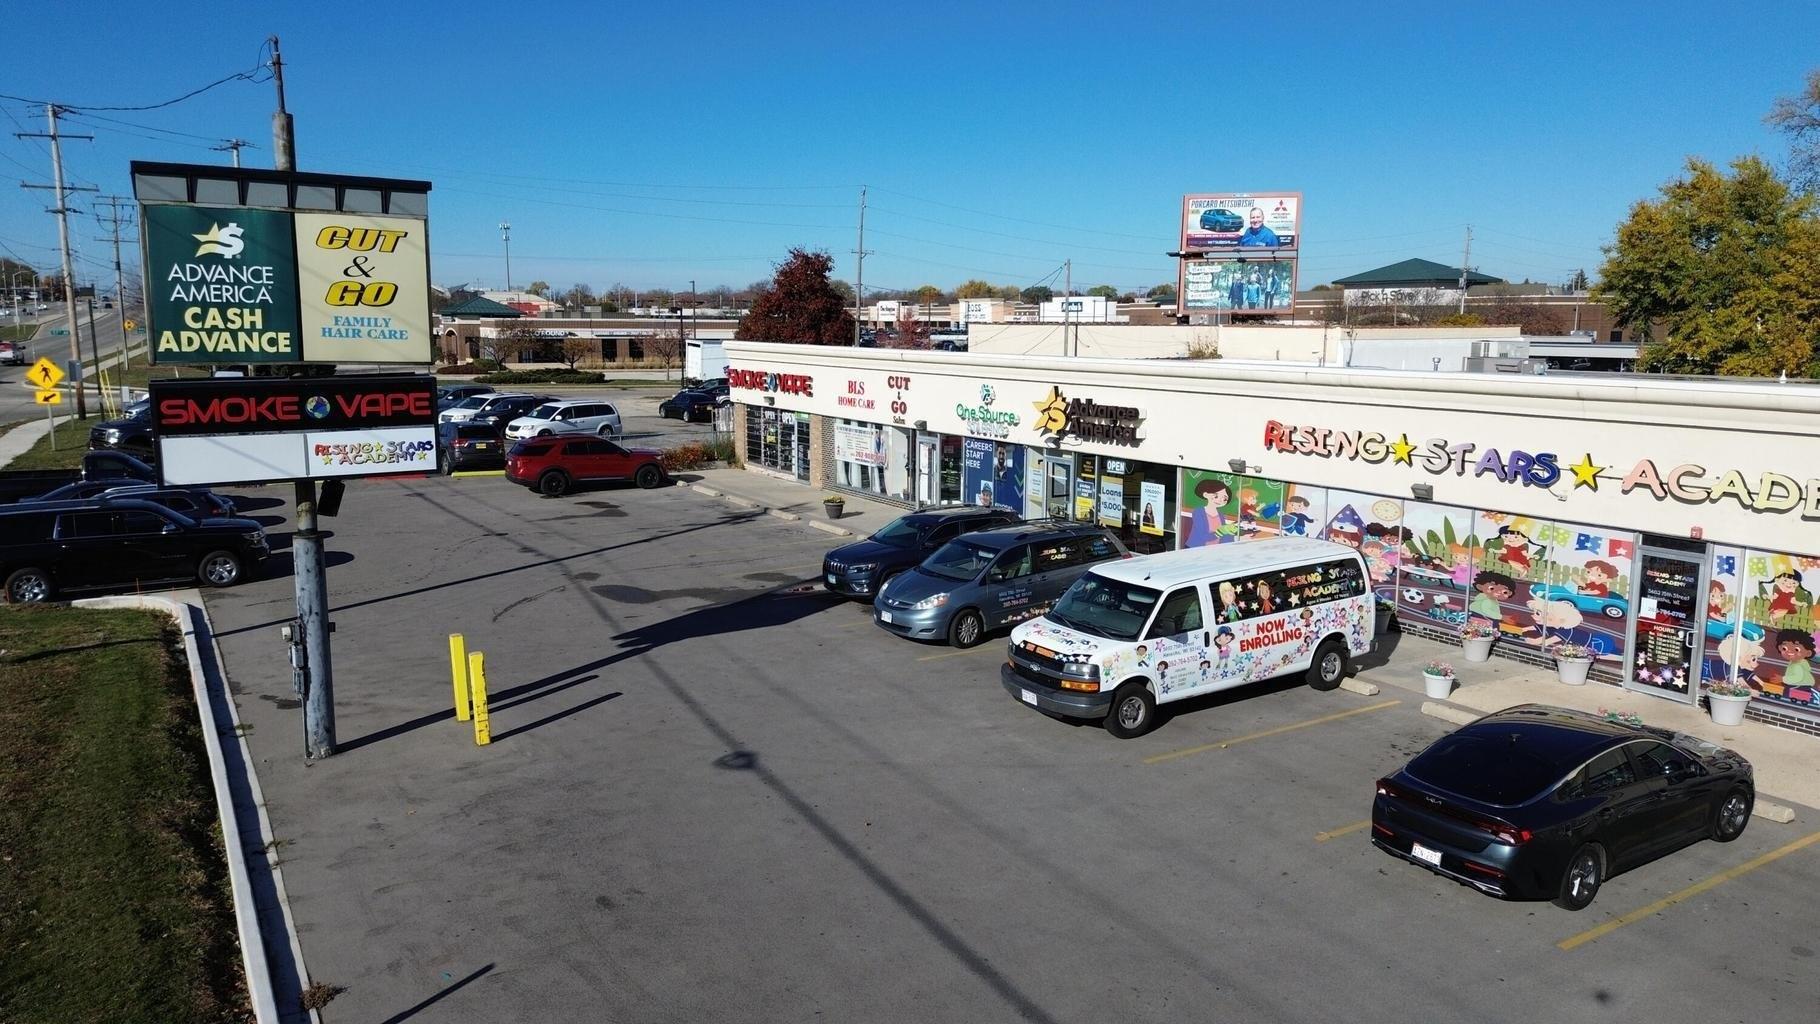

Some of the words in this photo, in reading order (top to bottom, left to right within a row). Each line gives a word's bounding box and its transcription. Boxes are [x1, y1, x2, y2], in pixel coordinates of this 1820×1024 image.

[316, 226, 408, 253] CUT
[168, 263, 274, 284] ADVANCE
[343, 256, 375, 278] &
[170, 283, 274, 304] AMERICA
[325, 281, 398, 307] GO
[184, 307, 263, 329] CASH
[333, 316, 391, 328] FAMILY
[321, 327, 362, 338] HAIR
[367, 329, 409, 340] CARE
[158, 331, 291, 353] ADVANCE
[728, 368, 768, 392] SMOKE
[777, 373, 814, 398] VAPE
[847, 380, 865, 395] BLS
[888, 376, 911, 391] CUT
[160, 396, 300, 424] SMOKE
[336, 392, 431, 418] VAPE
[838, 396, 857, 407] HOME
[858, 398, 875, 410] CARE
[891, 401, 907, 415] GO
[1069, 398, 1141, 421] Advance
[956, 403, 976, 419] One
[979, 405, 1016, 424] Source
[1069, 419, 1138, 441] America
[315, 443, 375, 457] RISING
[387, 441, 434, 452] STARS
[965, 442, 993, 452] CAREERS
[339, 451, 416, 466] ACADEMY
[965, 450, 985, 460] START
[965, 459, 981, 469] HERE
[1107, 460, 1125, 472] OPEN
[1264, 420, 1390, 465] RISING
[1421, 438, 1561, 488] STARS
[1621, 459, 1820, 521] ACADE
[1102, 487, 1122, 497] Loans
[1287, 572, 1322, 587] RISING
[1647, 570, 1670, 579] RISING
[1655, 578, 1686, 588] ACADEMY
[1256, 618, 1285, 635] NOW
[1653, 625, 1675, 634] HOURS
[1240, 627, 1303, 652] ENROLLING
